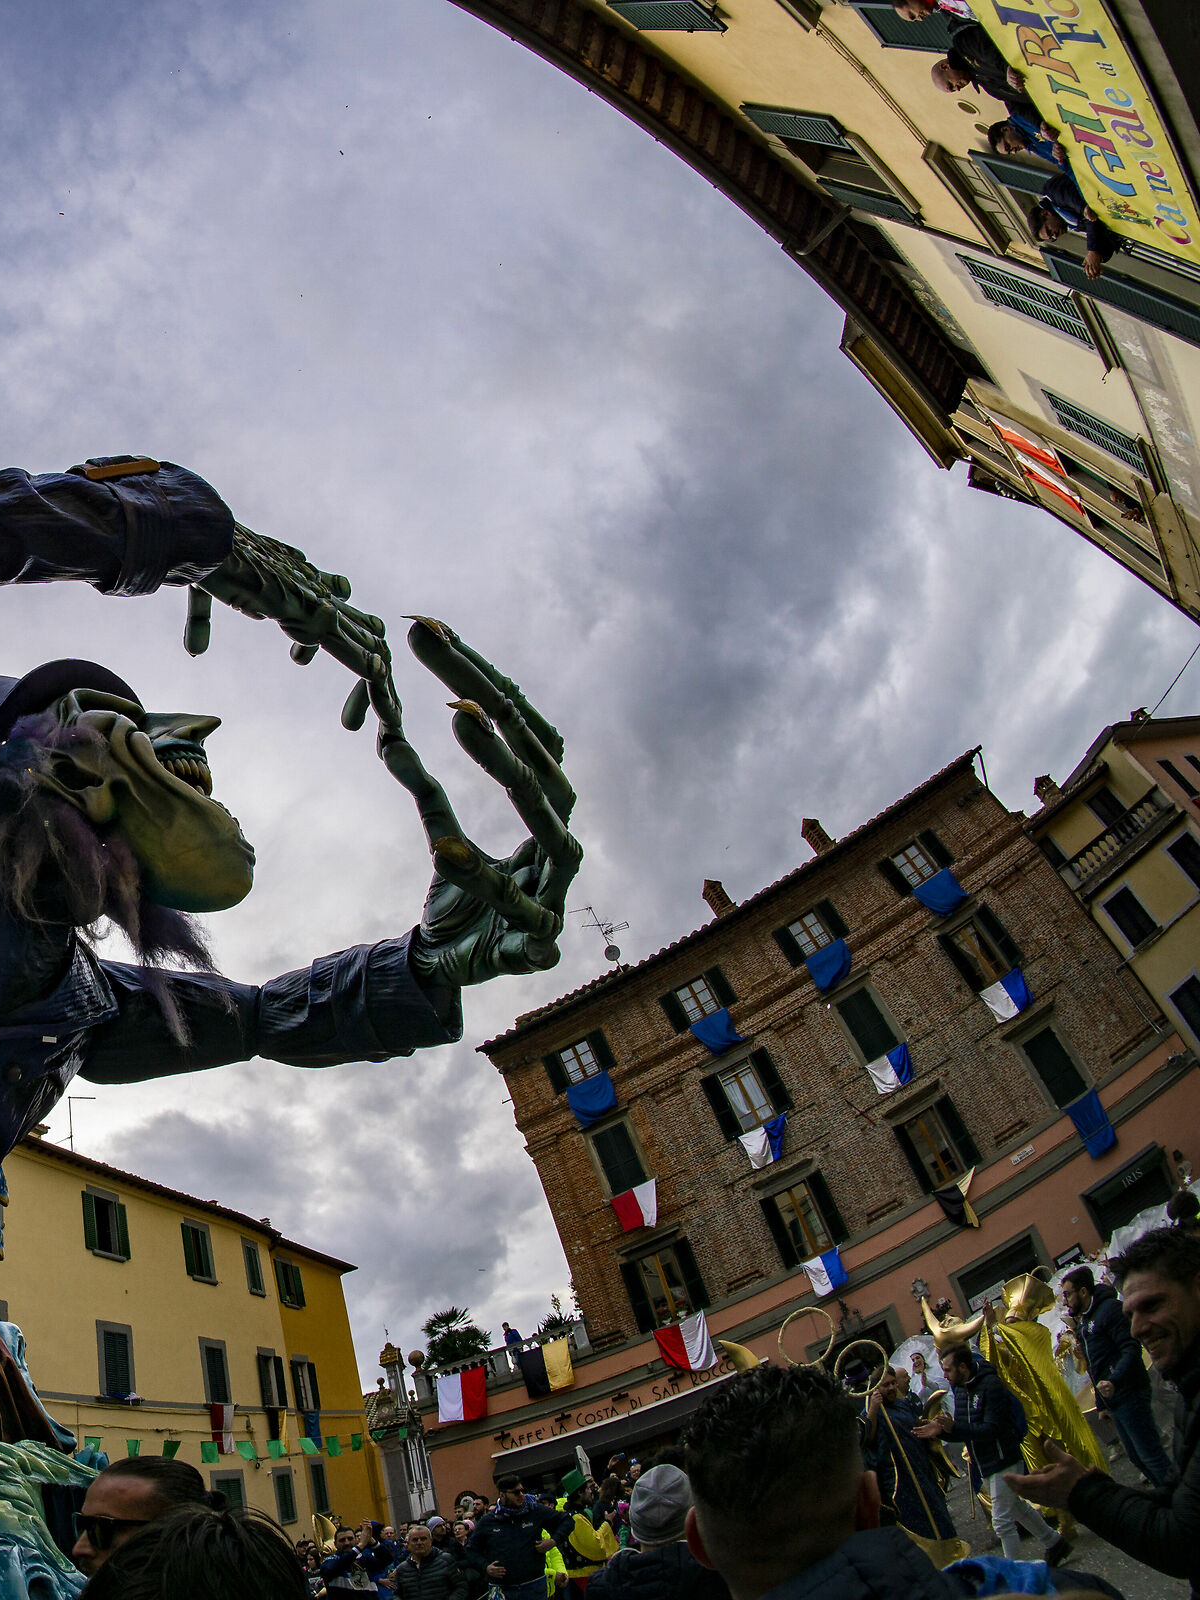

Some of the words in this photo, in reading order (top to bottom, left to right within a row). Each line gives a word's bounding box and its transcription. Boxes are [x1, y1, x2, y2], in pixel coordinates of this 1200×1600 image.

[1095, 61, 1117, 77] di
[991, 0, 1137, 197] GIURI
[1089, 87, 1192, 246] Canevale
[1121, 1168, 1144, 1188] IRIS
[550, 1422, 568, 1436] LA
[576, 1405, 619, 1427] COSTA
[629, 1397, 643, 1410] DI
[651, 1383, 680, 1401] SAN
